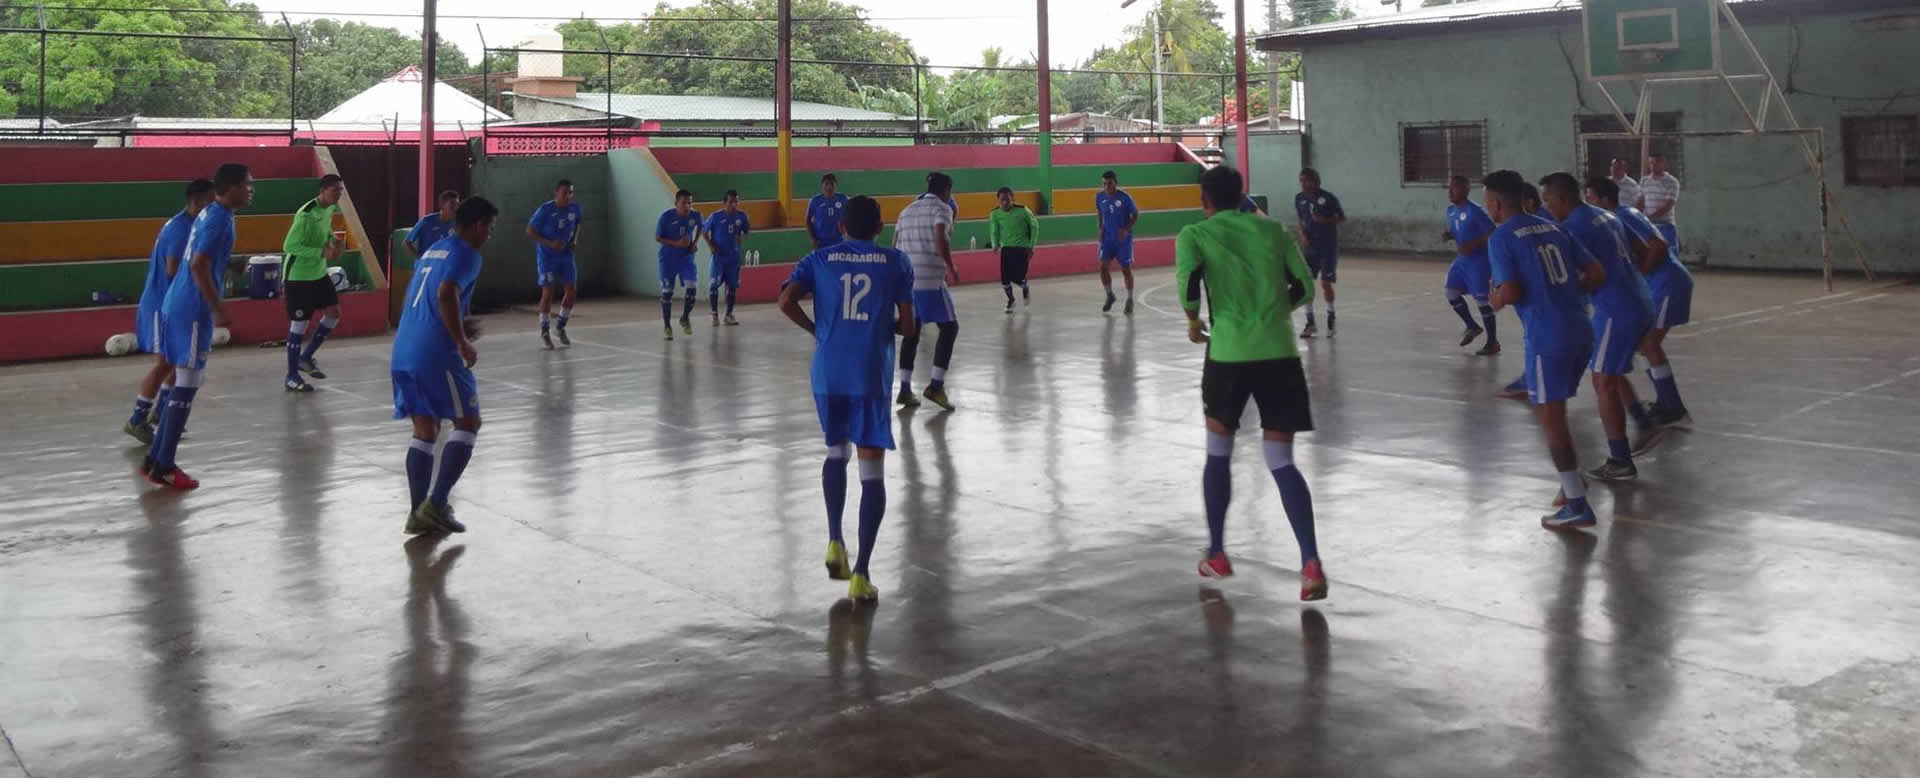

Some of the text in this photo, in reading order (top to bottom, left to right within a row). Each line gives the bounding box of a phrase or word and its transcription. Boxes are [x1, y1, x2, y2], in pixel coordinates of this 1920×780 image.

[827, 251, 888, 265] NICARAGUA
[1537, 243, 1569, 285] 10
[412, 265, 432, 308] 7
[839, 272, 872, 321] 12
